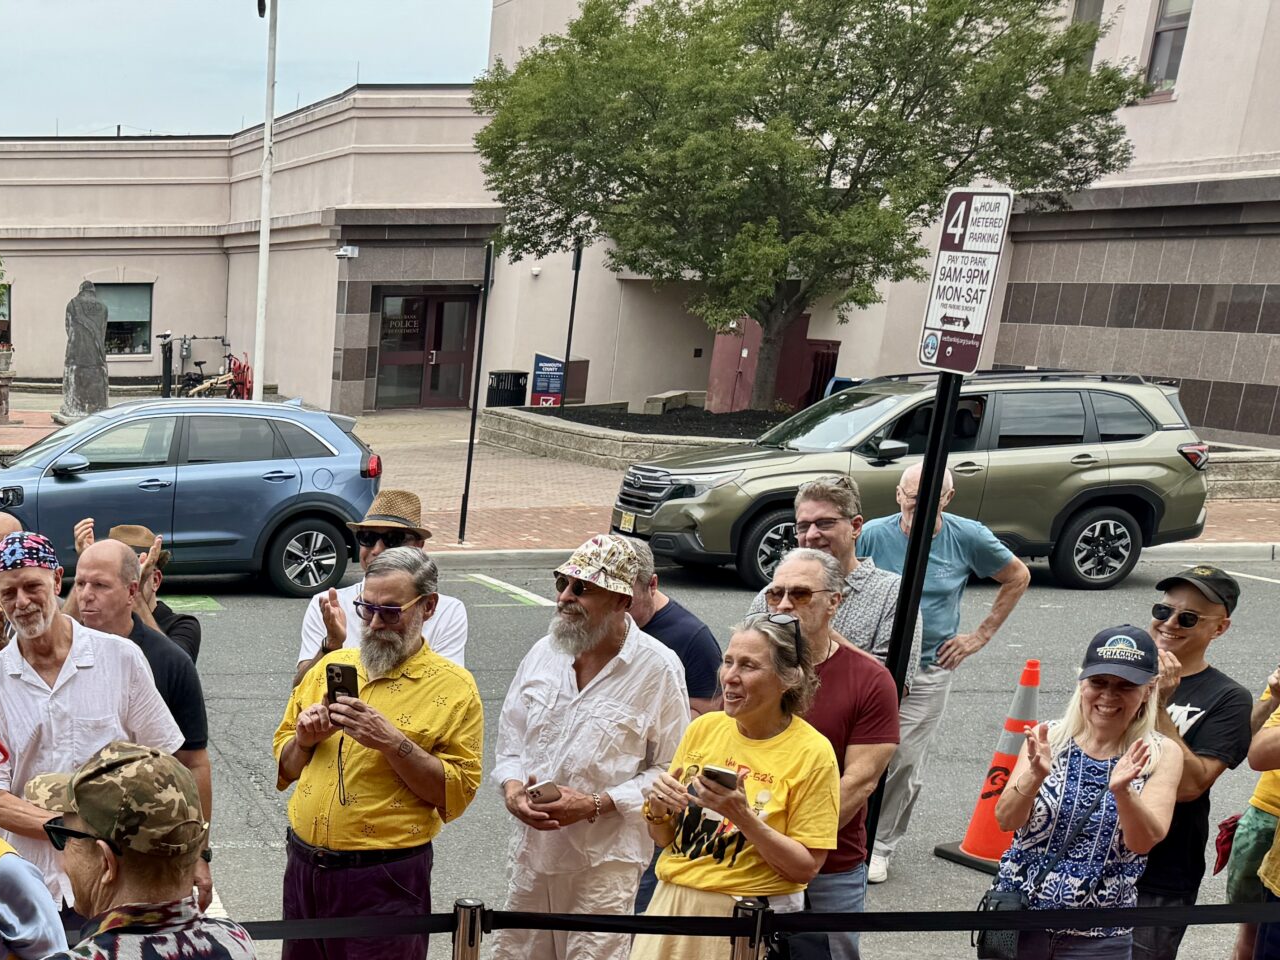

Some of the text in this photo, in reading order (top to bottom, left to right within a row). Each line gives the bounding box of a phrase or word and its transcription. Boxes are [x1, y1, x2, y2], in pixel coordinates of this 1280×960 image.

[979, 202, 1001, 212] HOUR
[946, 201, 966, 244] 4
[970, 217, 1004, 228] METERED
[968, 232, 999, 243] PARKING
[947, 255, 987, 266] PAY TO PARK
[939, 266, 990, 285] 9AM-9PM
[936, 285, 986, 304] MON-SAT
[390, 320, 419, 328] POLICE
[1098, 649, 1142, 660] CENTENNIAL
[725, 756, 736, 767] the
